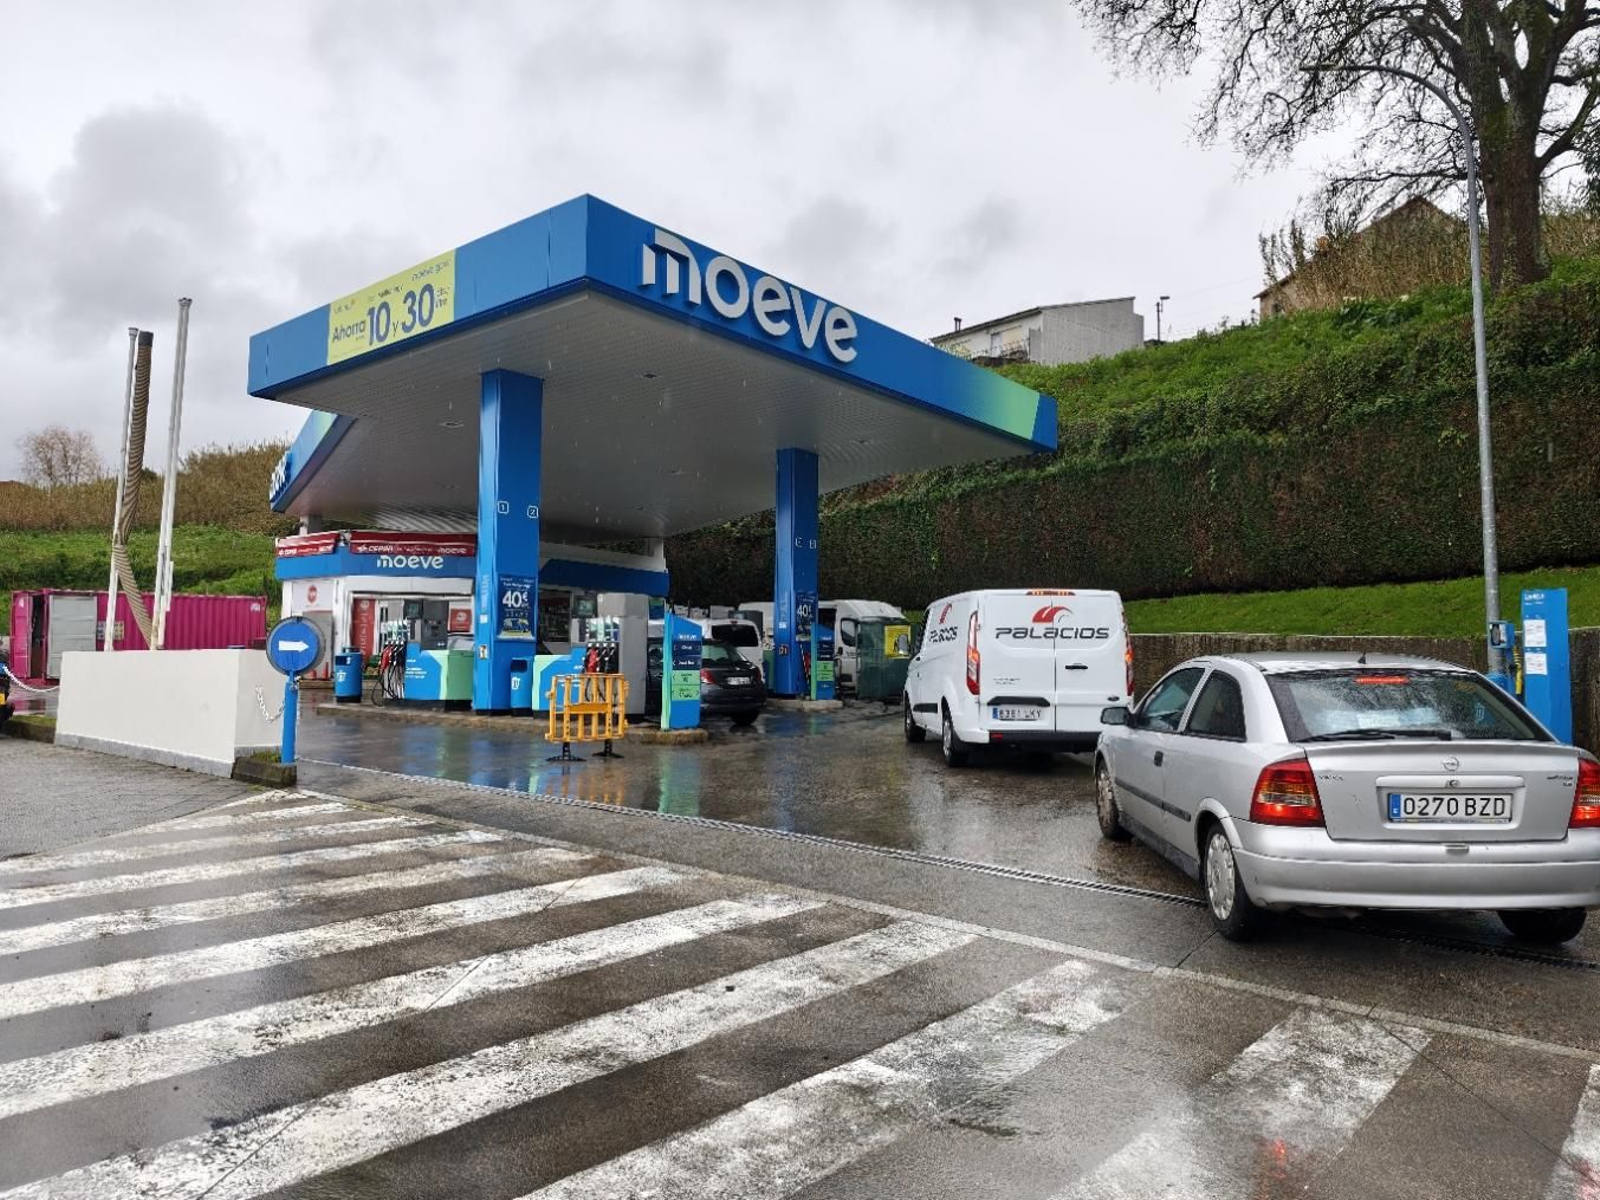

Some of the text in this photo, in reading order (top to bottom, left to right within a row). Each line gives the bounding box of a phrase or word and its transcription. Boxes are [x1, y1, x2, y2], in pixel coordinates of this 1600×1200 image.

[332, 320, 366, 343] Ahorra
[366, 301, 391, 346] 10
[392, 321, 399, 337] y
[402, 283, 435, 333] 30
[642, 228, 858, 363] moeve
[377, 554, 444, 569] moeve
[1403, 796, 1506, 816] 0270 BZD
